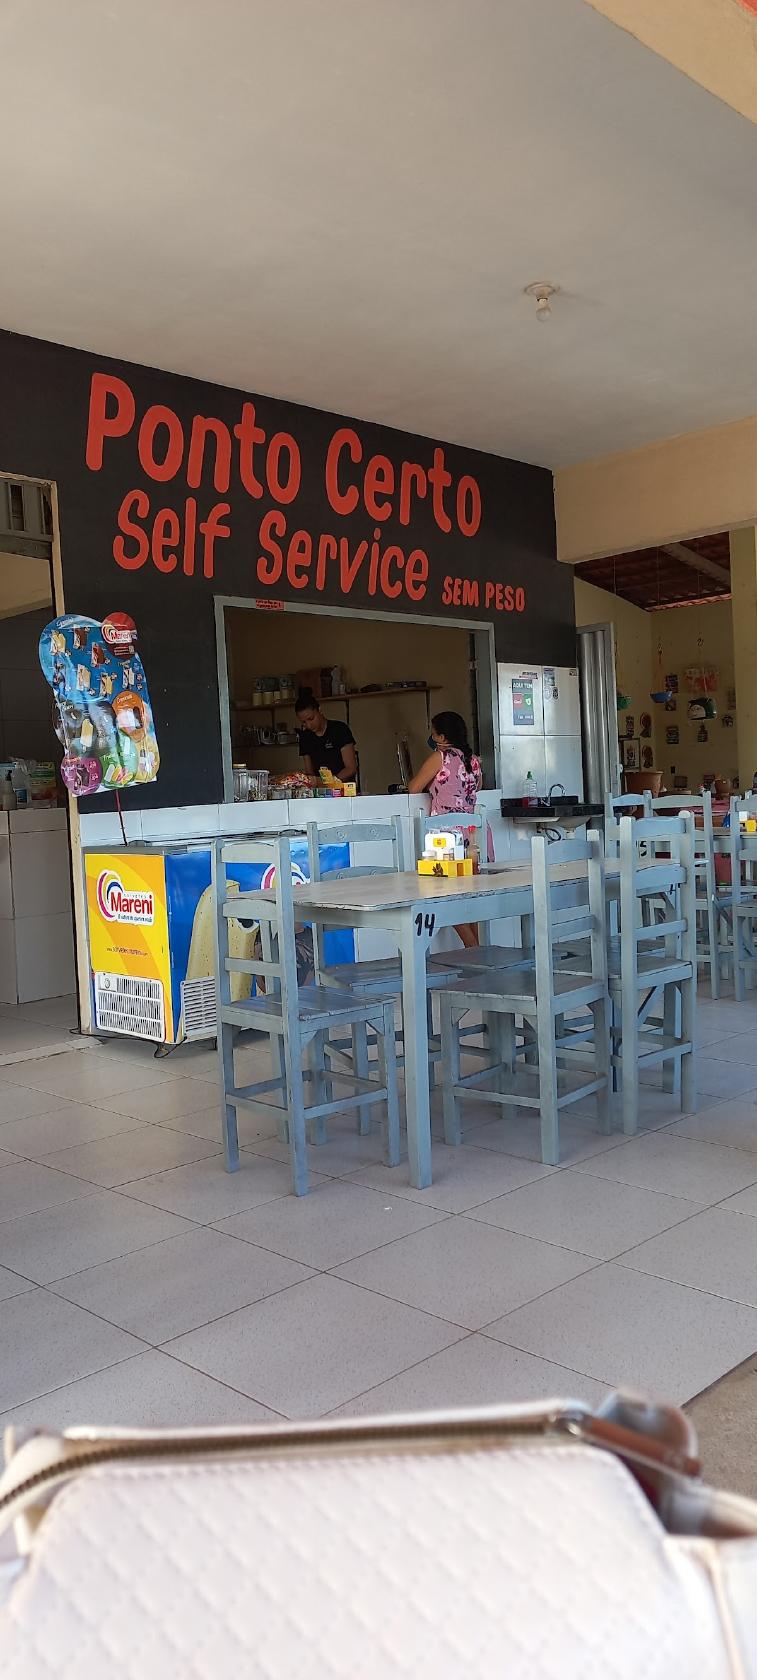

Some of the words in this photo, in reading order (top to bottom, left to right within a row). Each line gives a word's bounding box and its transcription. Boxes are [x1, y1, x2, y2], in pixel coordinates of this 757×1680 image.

[86, 373, 301, 505] Ponto
[325, 428, 481, 537] Certo
[112, 489, 231, 578] Self
[256, 509, 429, 601] Service
[442, 575, 479, 606] SEM
[485, 582, 525, 612] PESO
[110, 891, 153, 915] Mareni
[414, 912, 436, 937] 14
